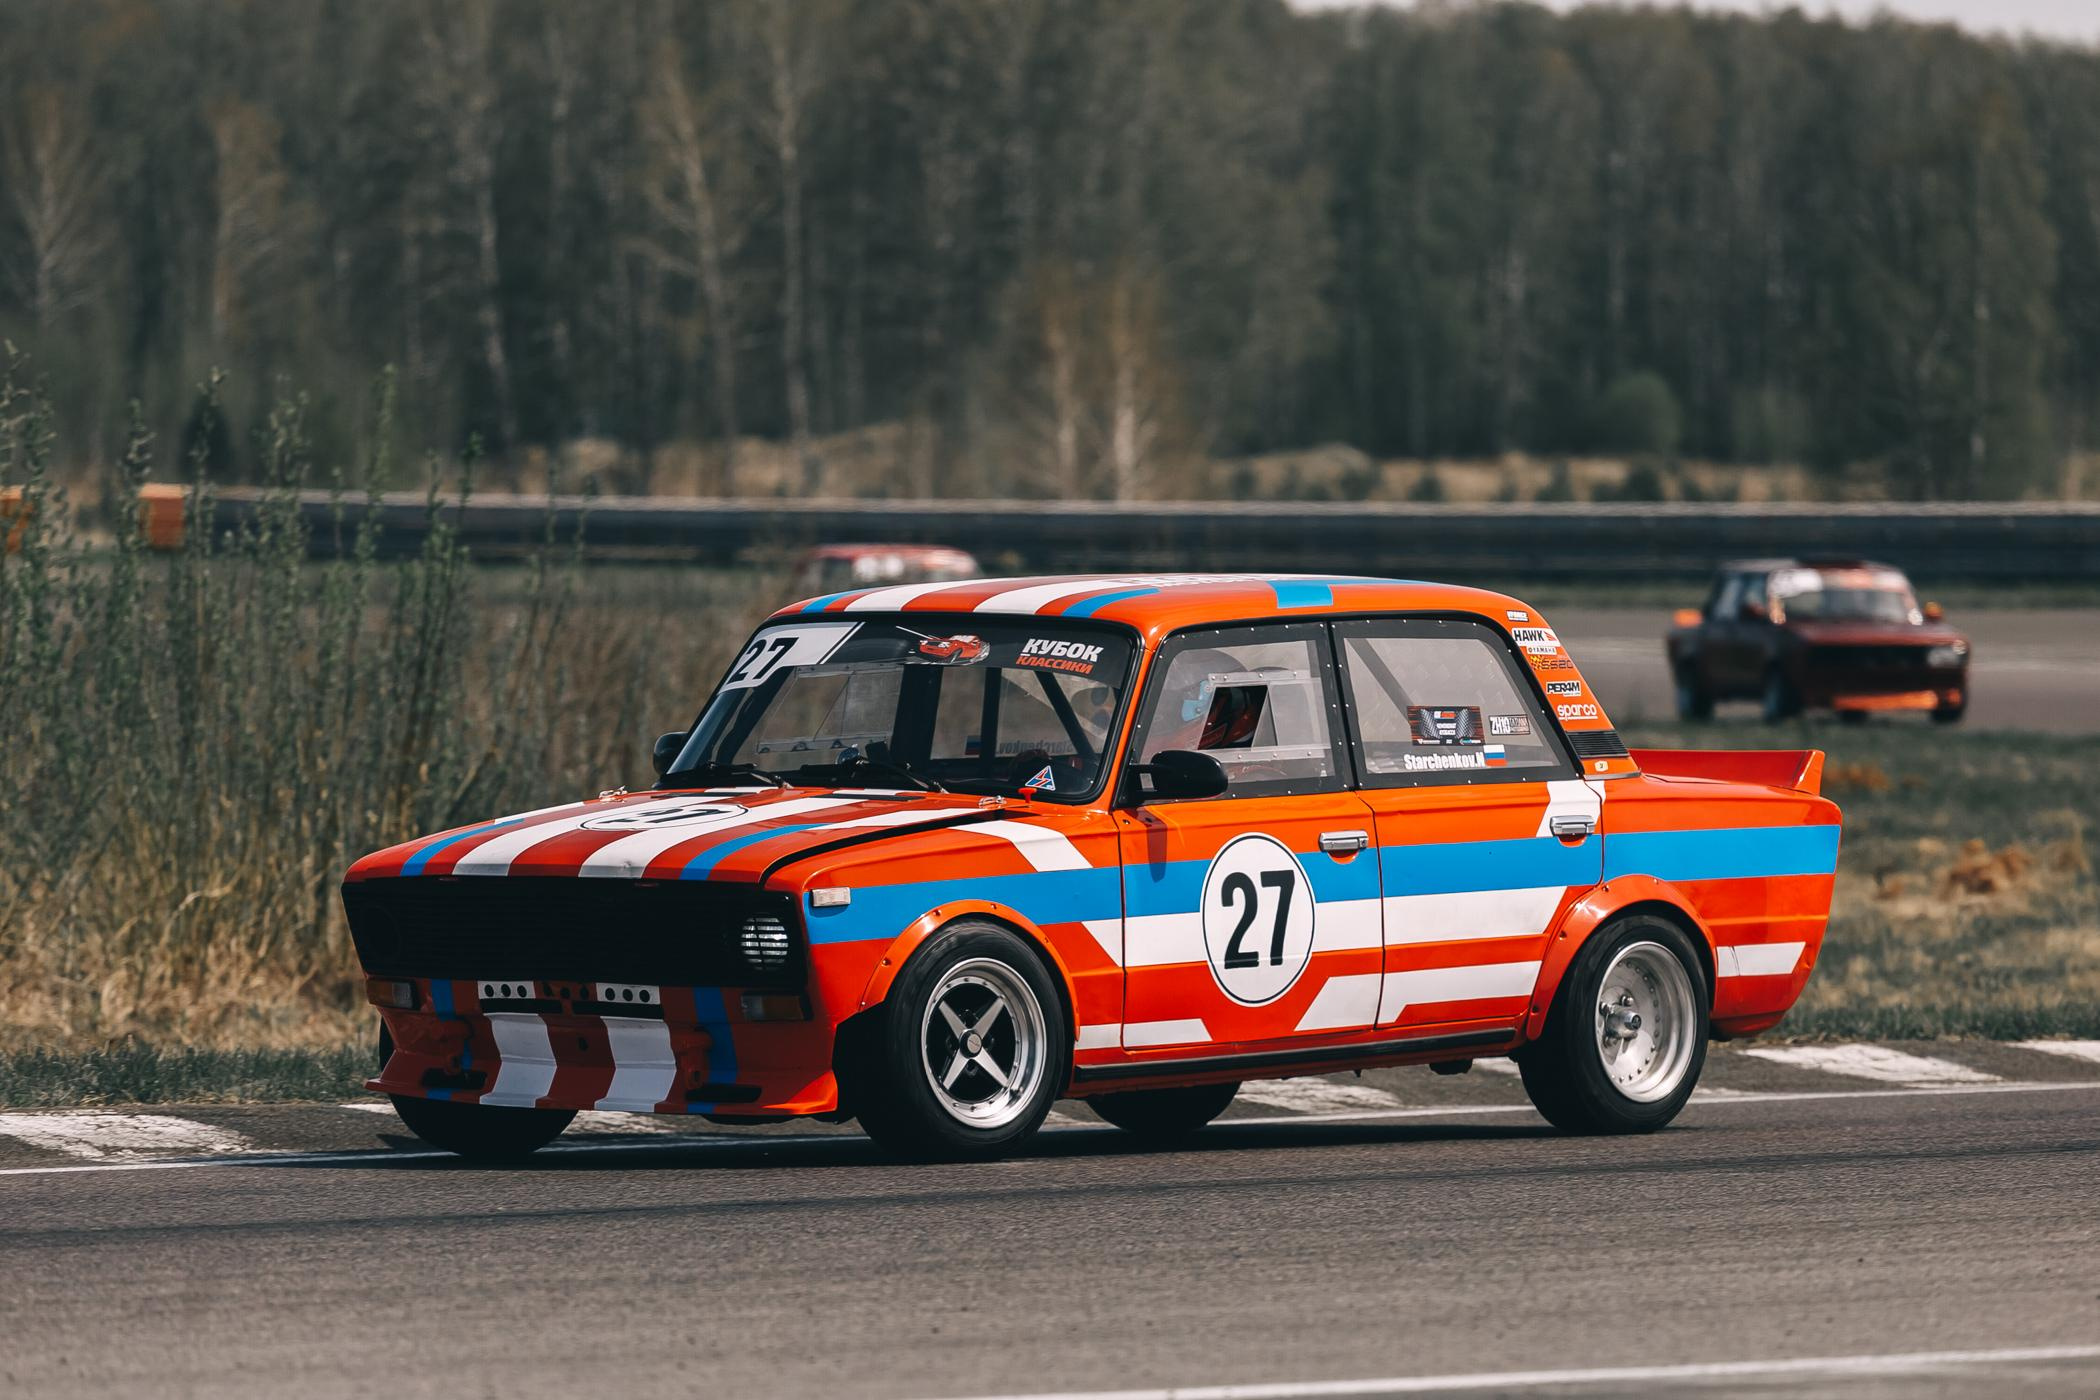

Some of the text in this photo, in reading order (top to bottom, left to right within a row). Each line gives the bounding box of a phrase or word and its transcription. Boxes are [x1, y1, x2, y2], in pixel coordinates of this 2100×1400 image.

[1514, 629, 1545, 642] HAWK
[1022, 638, 1104, 662] КУБОК
[726, 637, 799, 685] 27
[1016, 656, 1094, 674] КЛАССИКИ
[1557, 704, 1597, 719] sparco
[1221, 869, 1296, 969] 27
